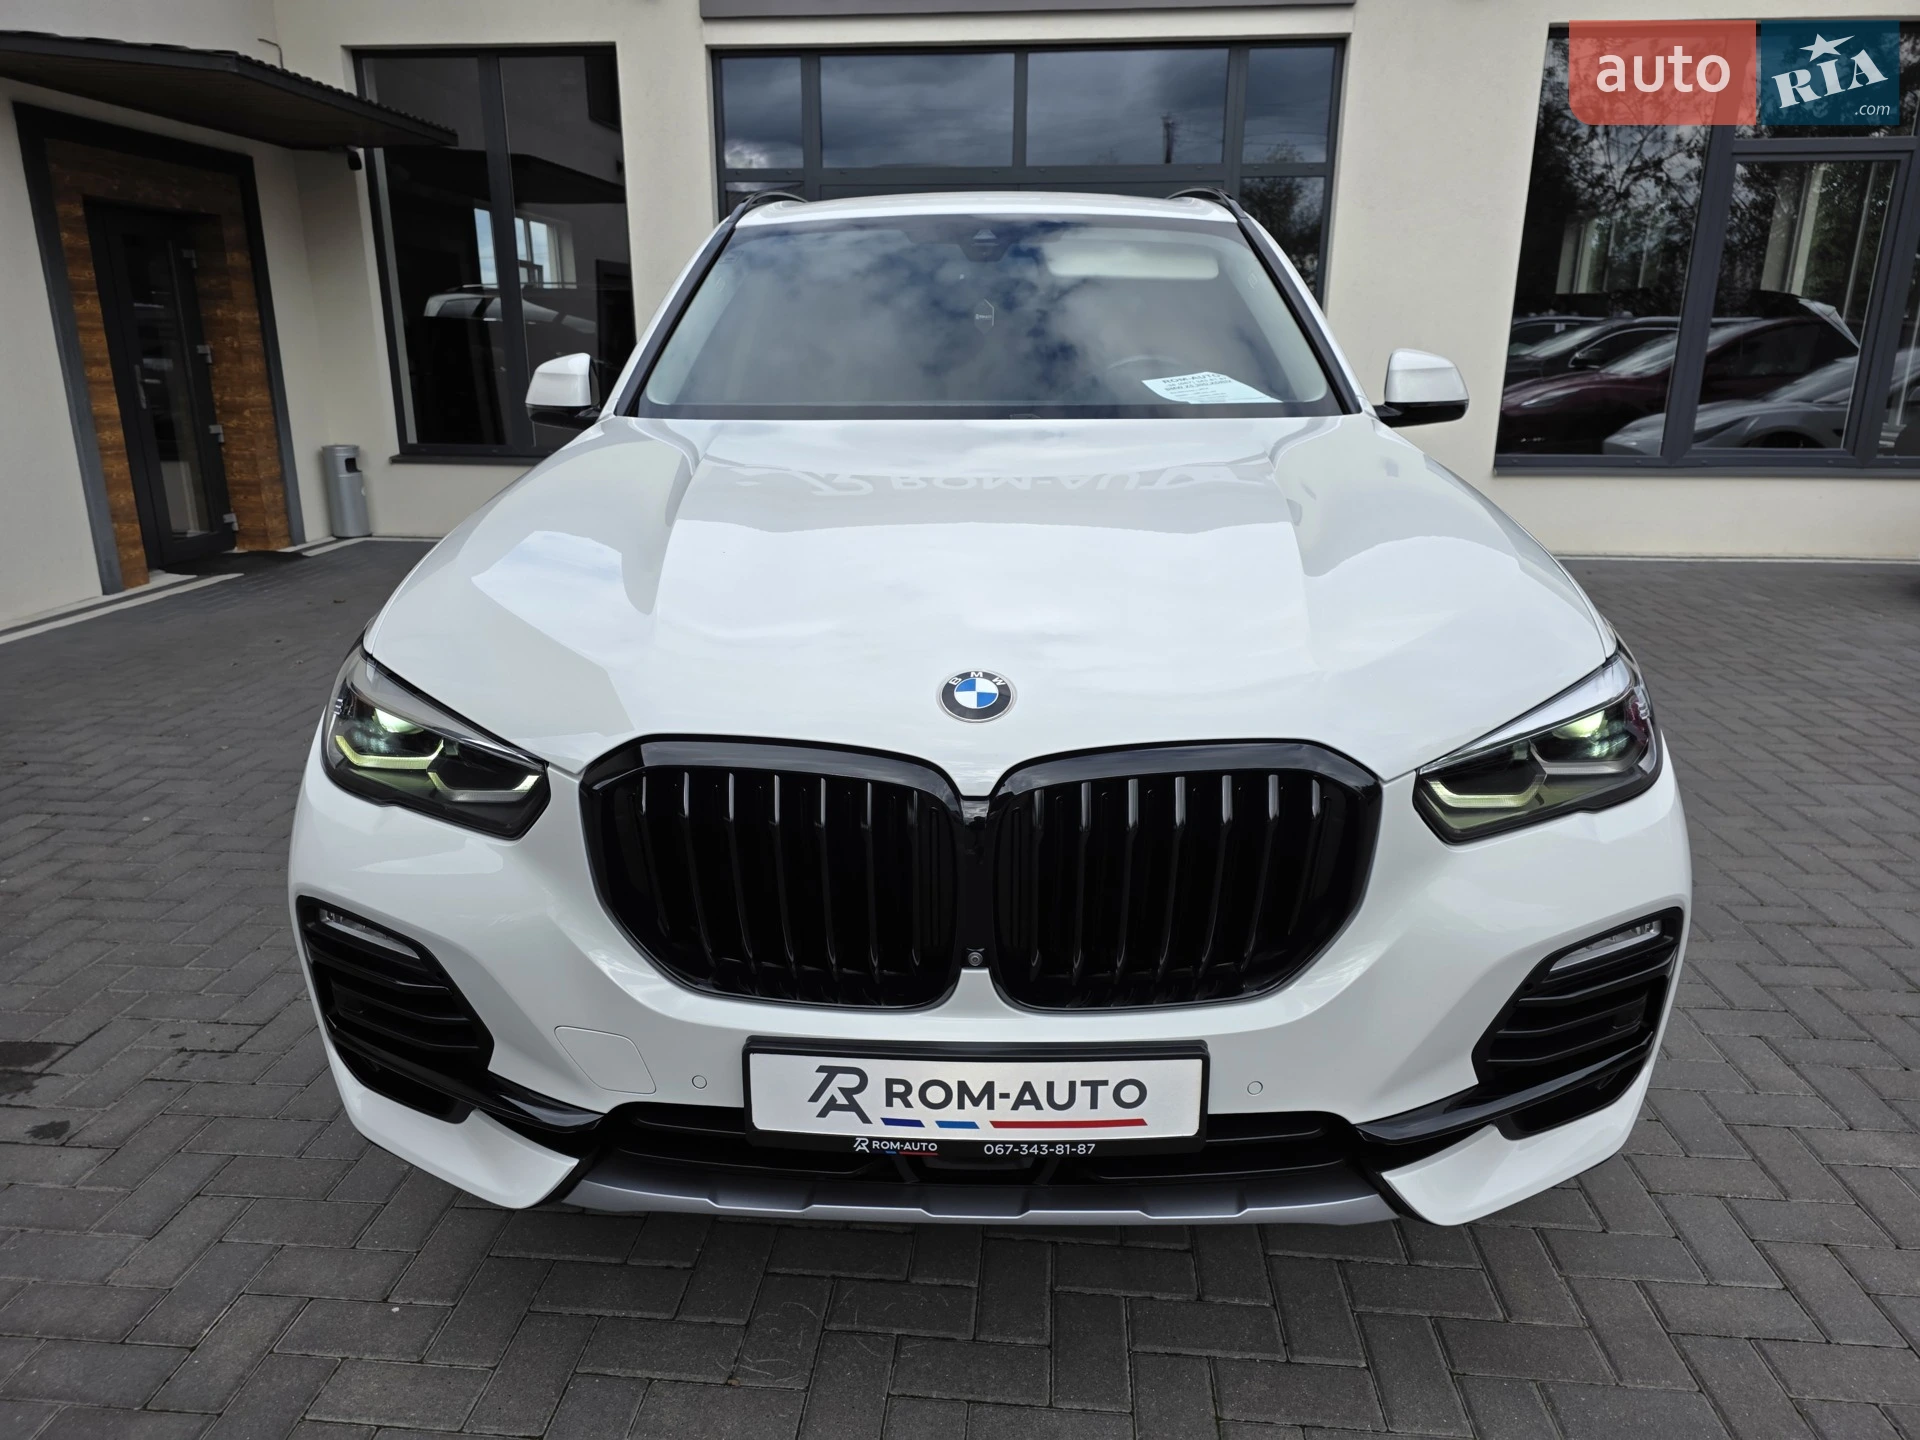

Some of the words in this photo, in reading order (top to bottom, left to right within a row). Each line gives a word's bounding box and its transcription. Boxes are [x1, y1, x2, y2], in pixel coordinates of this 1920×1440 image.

[948, 671, 1007, 686] BMW
[884, 1077, 1149, 1112] ROM-AUTO
[871, 1140, 938, 1152] ROM-AUTO
[983, 1143, 1096, 1155] 067-343-81-87
